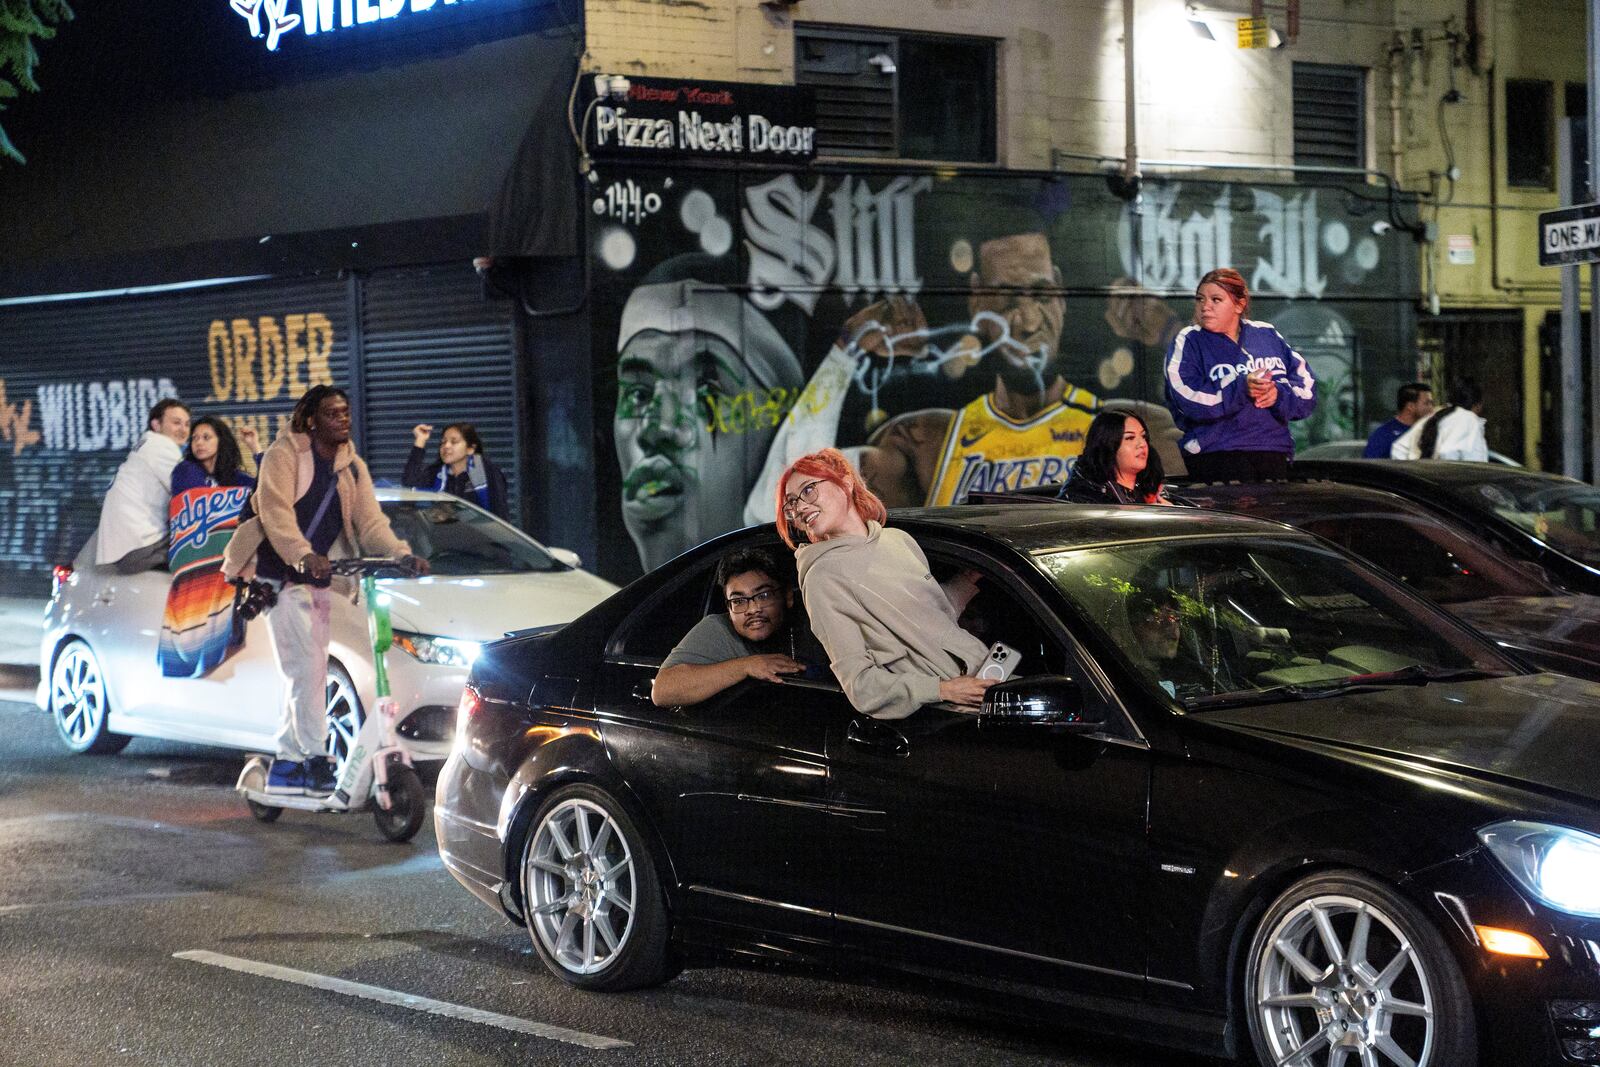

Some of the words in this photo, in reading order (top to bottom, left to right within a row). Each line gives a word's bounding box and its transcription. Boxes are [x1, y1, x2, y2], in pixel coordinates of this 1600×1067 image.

[596, 105, 675, 148] Pizza
[678, 110, 743, 152] Next
[748, 114, 816, 154] Door
[741, 173, 933, 317] Still
[1550, 226, 1580, 248] ONE
[1584, 222, 1600, 244] W
[207, 312, 334, 402] ORDER
[37, 378, 178, 451] WILDBIR
